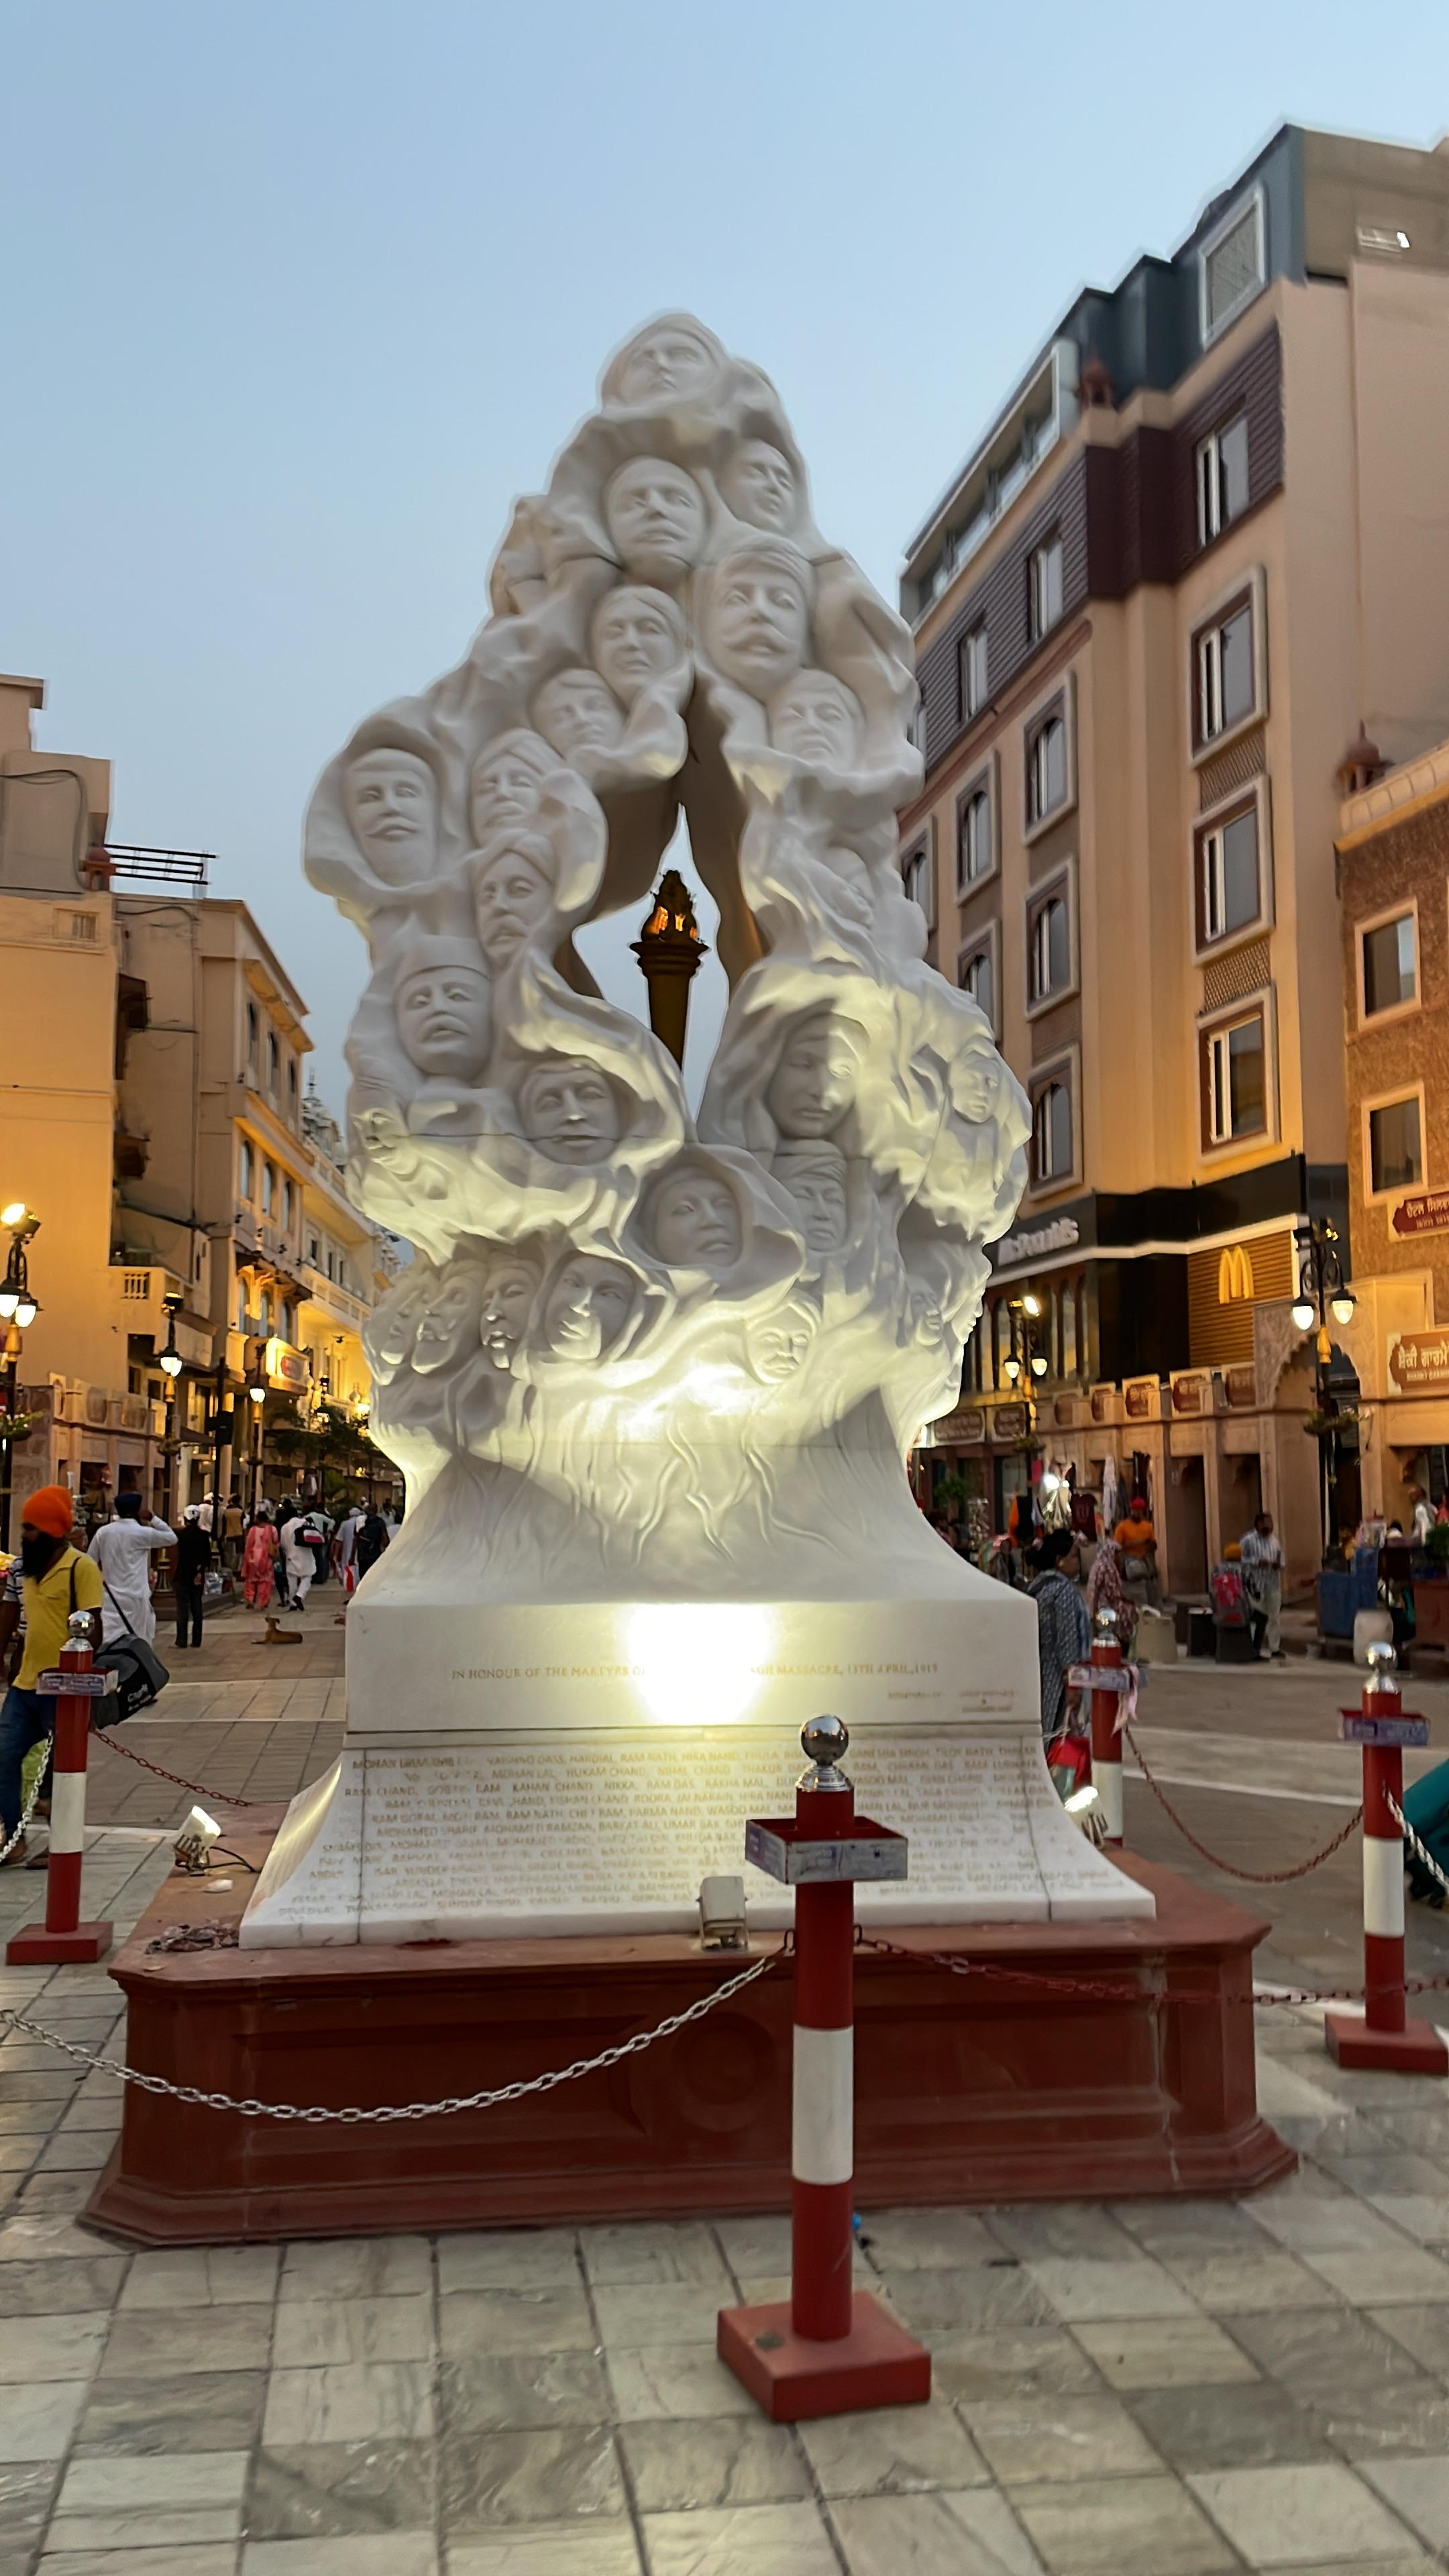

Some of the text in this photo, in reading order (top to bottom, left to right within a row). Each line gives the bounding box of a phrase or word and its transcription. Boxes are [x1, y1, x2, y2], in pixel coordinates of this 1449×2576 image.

[452, 1670, 465, 1679] IN
[469, 1668, 521, 1678] HONOUR
[525, 1668, 541, 1678] OF
[545, 1667, 568, 1677] THE
